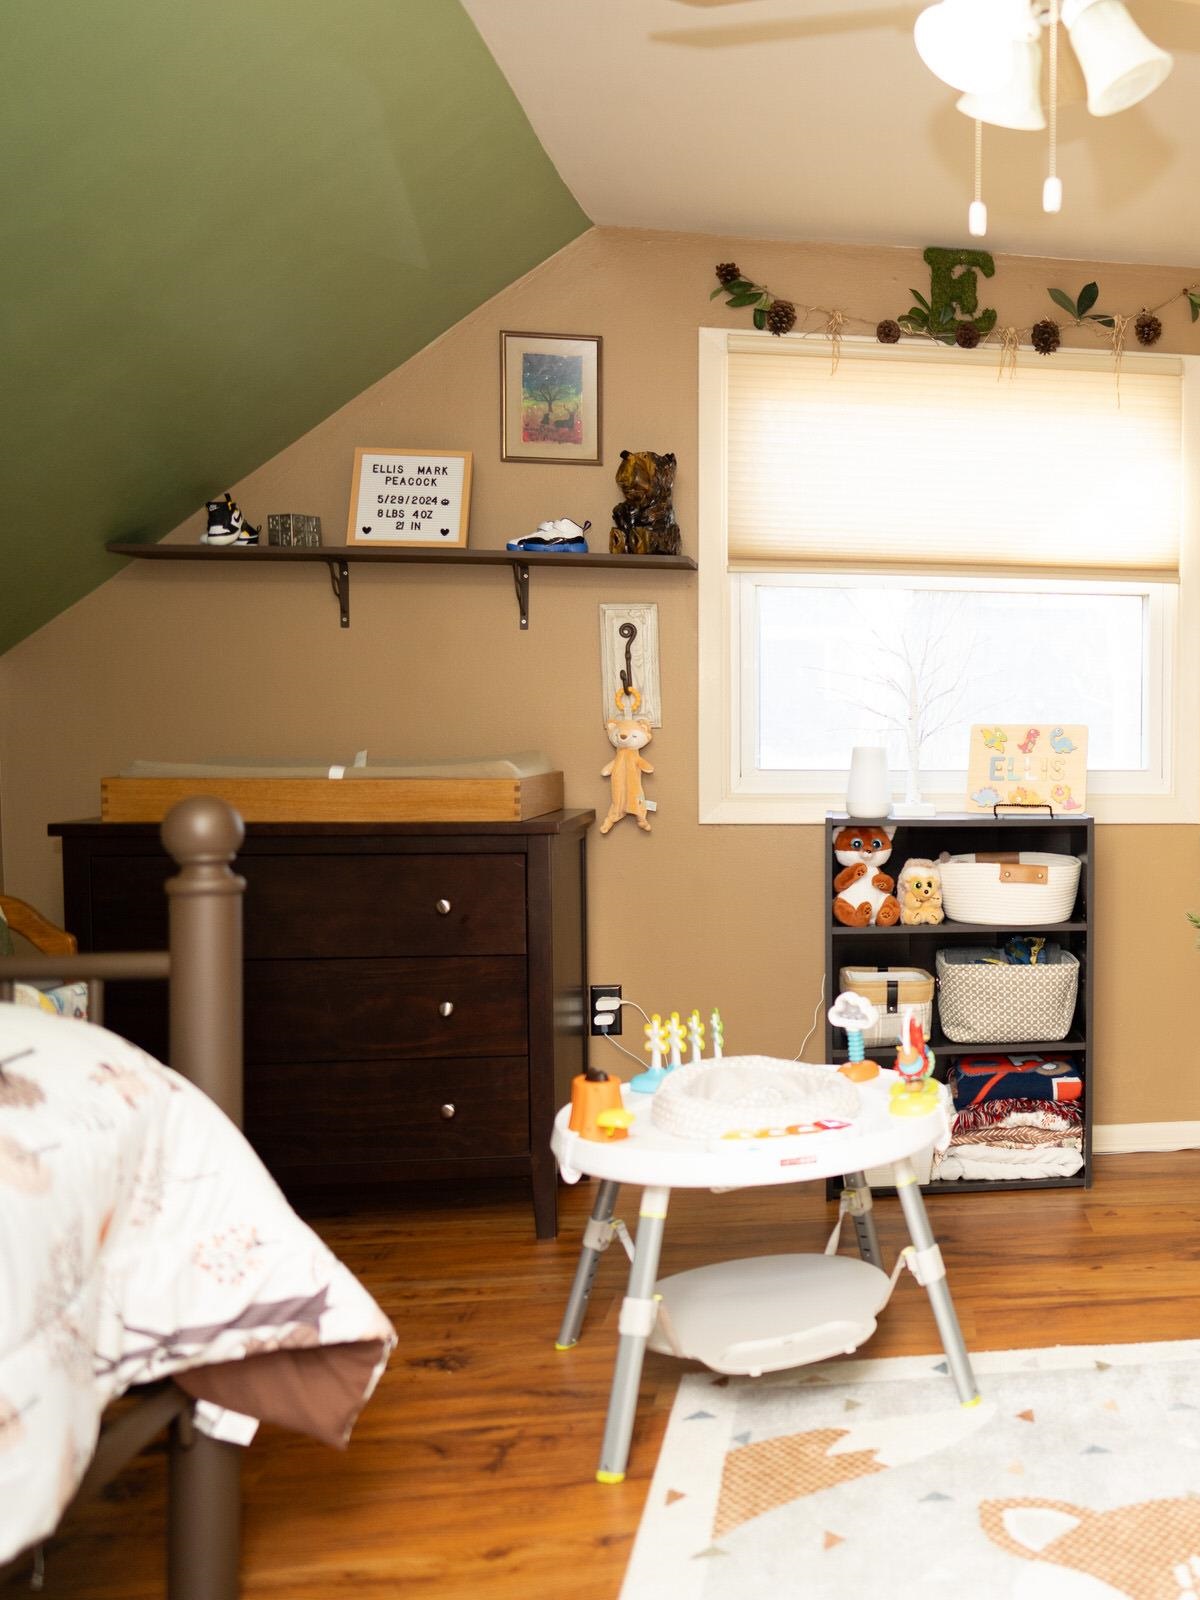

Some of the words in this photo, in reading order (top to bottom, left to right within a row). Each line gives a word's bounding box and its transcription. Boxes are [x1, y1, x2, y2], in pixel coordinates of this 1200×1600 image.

[923, 246, 997, 336] E
[372, 464, 404, 474] ELLIS
[417, 466, 448, 476] MARK
[385, 476, 437, 487] PEACOCK
[377, 495, 438, 506] 5/29/2024
[395, 521, 405, 531] 21
[411, 521, 421, 531] IN
[989, 756, 1066, 782] ELLIS
